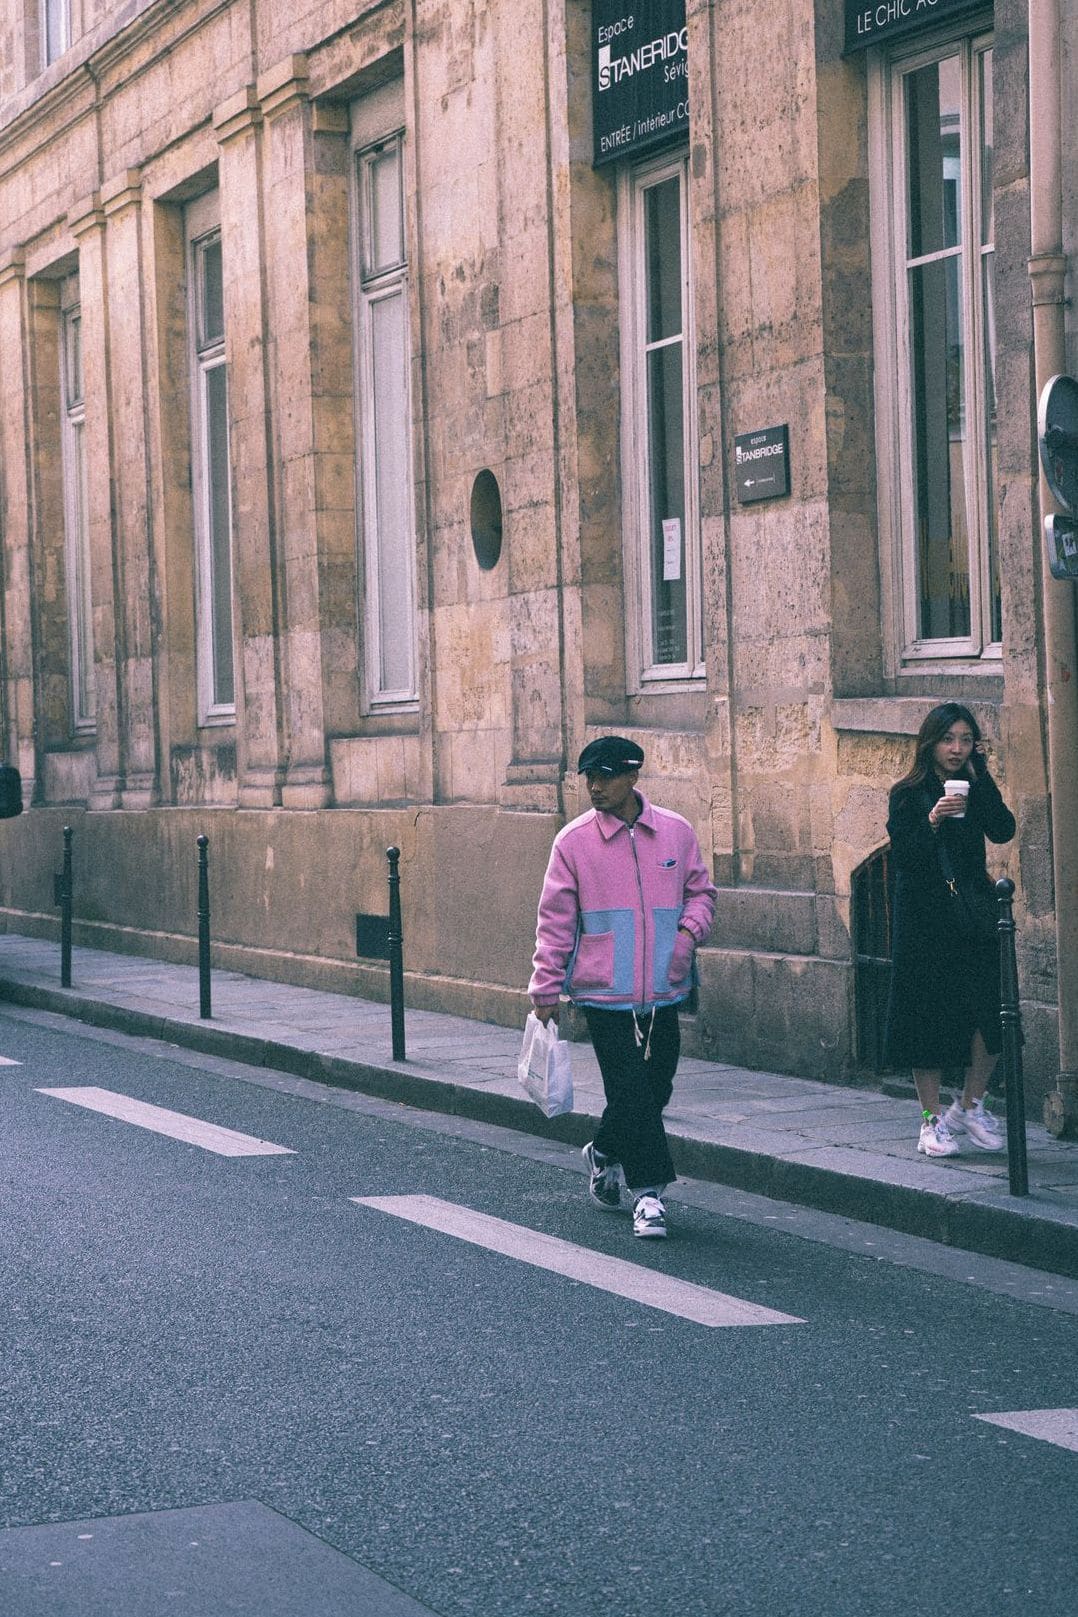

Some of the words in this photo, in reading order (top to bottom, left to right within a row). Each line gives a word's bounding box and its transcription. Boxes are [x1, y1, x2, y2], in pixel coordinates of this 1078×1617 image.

[598, 15, 635, 43] Espace
[857, 10, 872, 34] LE
[875, 0, 911, 26] CHIC
[600, 123, 631, 152] ENTRÉE
[637, 109, 676, 135] intérieur
[736, 443, 784, 465] STANBRIDGE
